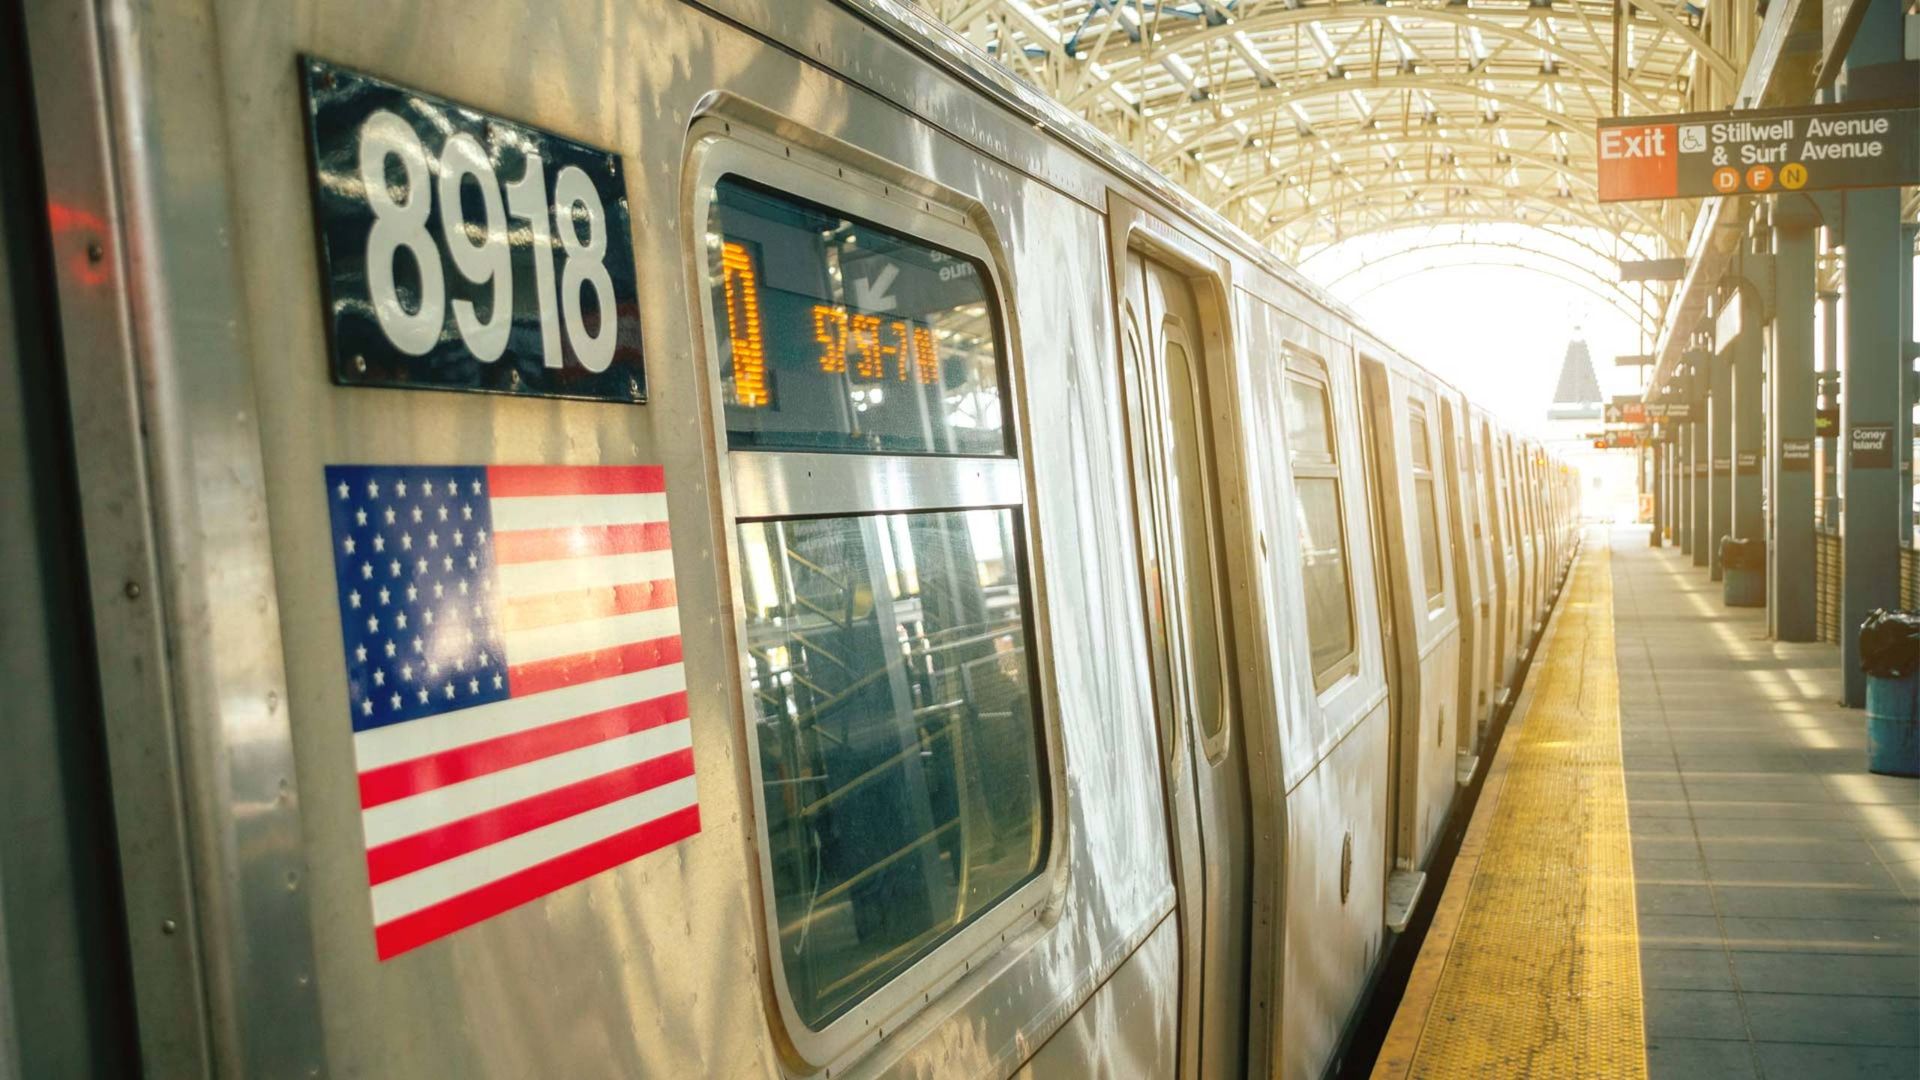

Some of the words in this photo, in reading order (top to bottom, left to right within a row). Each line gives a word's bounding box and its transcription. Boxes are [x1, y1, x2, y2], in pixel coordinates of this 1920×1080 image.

[1711, 119, 1794, 144] Stillwell
[1806, 117, 1889, 138] Avenue
[1600, 128, 1665, 160] Exit
[1711, 146, 1728, 166] &
[1741, 143, 1788, 164] Surf
[1800, 140, 1883, 161] Avenue
[1720, 172, 1734, 188] D
[1754, 170, 1765, 186] F
[1787, 169, 1800, 184] N
[360, 108, 618, 374] 8918
[1853, 429, 1886, 441] Coney
[1853, 440, 1882, 450] Island
